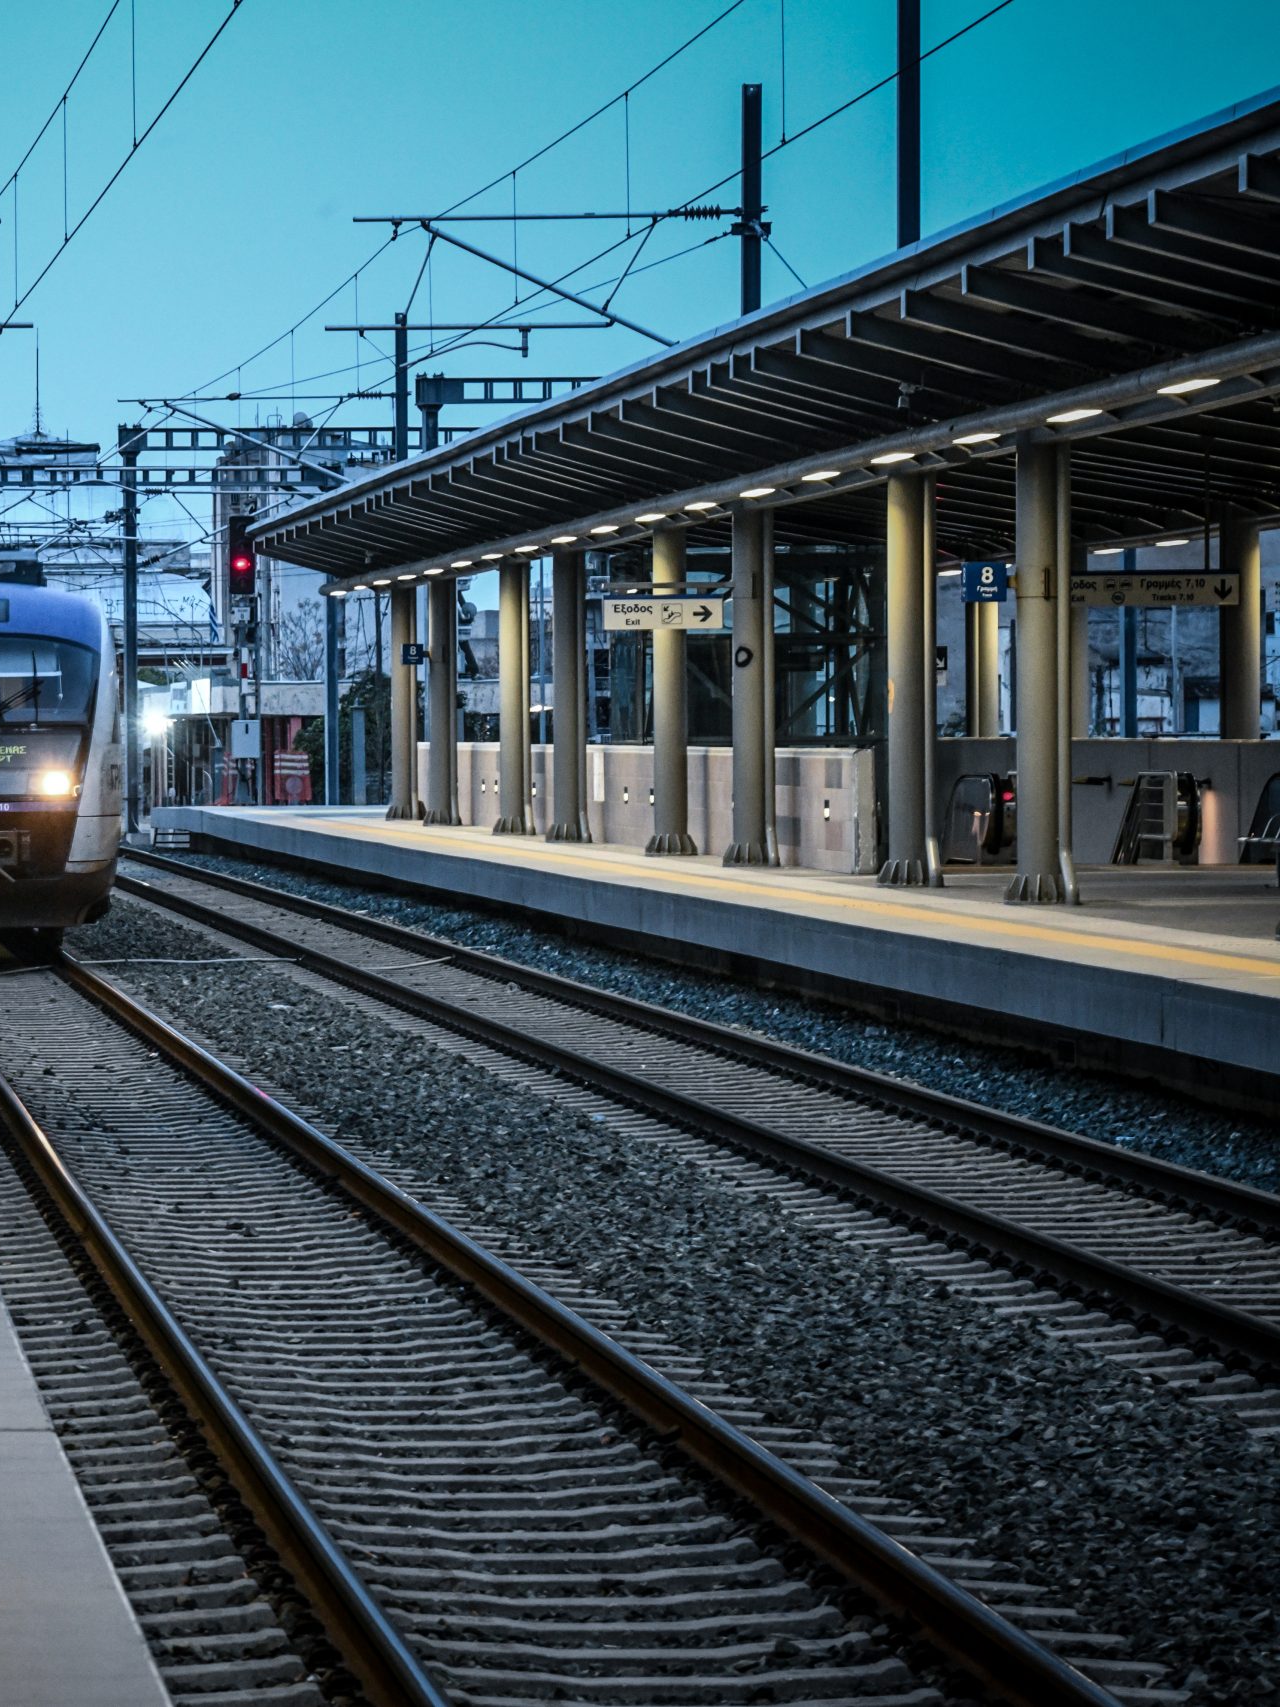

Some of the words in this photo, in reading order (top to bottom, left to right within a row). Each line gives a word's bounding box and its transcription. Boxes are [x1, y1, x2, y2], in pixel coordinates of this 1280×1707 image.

[981, 566, 994, 584] 8
[1071, 580, 1097, 591] οδος
[1140, 577, 1182, 590] Γραμμές
[612, 603, 653, 615] Έξοδος
[625, 618, 641, 626] Exit
[409, 646, 417, 656] 8
